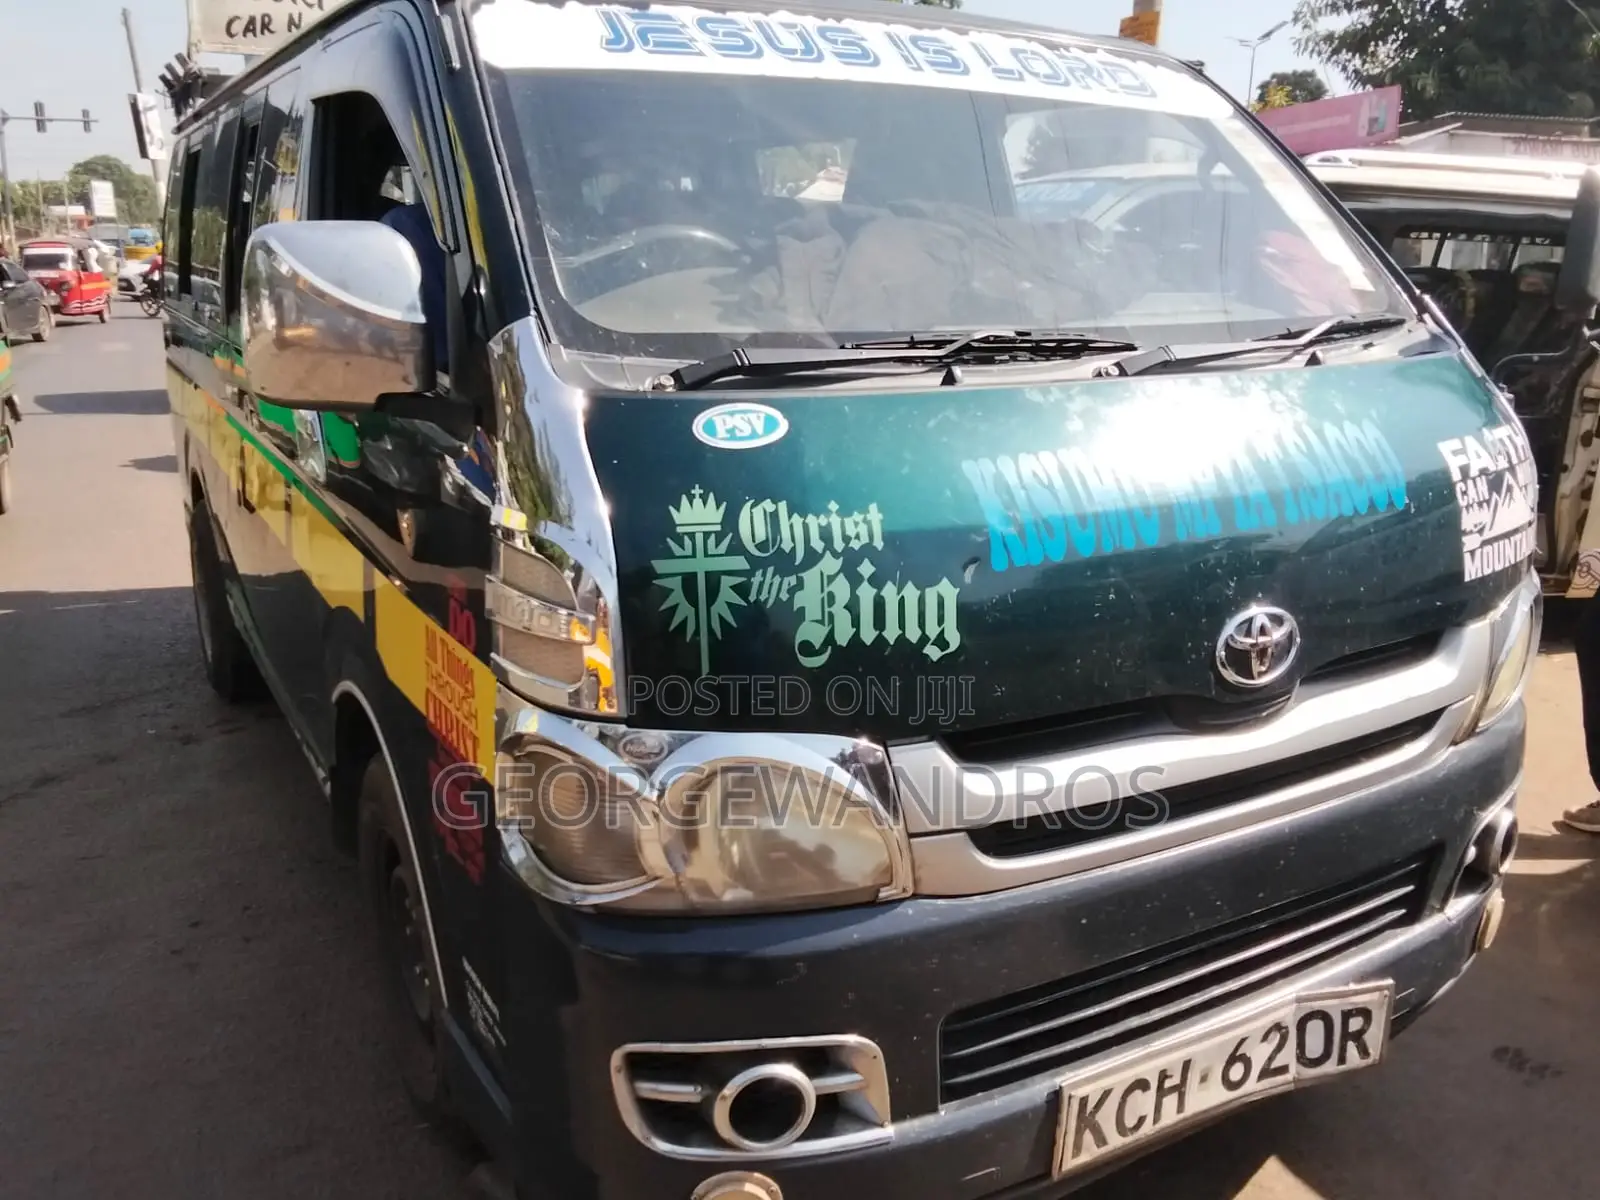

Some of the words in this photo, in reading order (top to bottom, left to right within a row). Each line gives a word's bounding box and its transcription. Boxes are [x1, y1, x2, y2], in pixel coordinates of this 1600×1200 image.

[225, 13, 275, 38] CAR
[600, 7, 880, 66] JESUS
[887, 32, 972, 75] IS
[973, 41, 1158, 99] LORD
[712, 411, 767, 439] PSV
[1456, 475, 1490, 506] CAN
[738, 498, 885, 565] Christ
[748, 565, 798, 608] the
[793, 549, 961, 668] King
[1071, 1058, 1193, 1160] KCH
[1220, 1006, 1374, 1093] 620R
